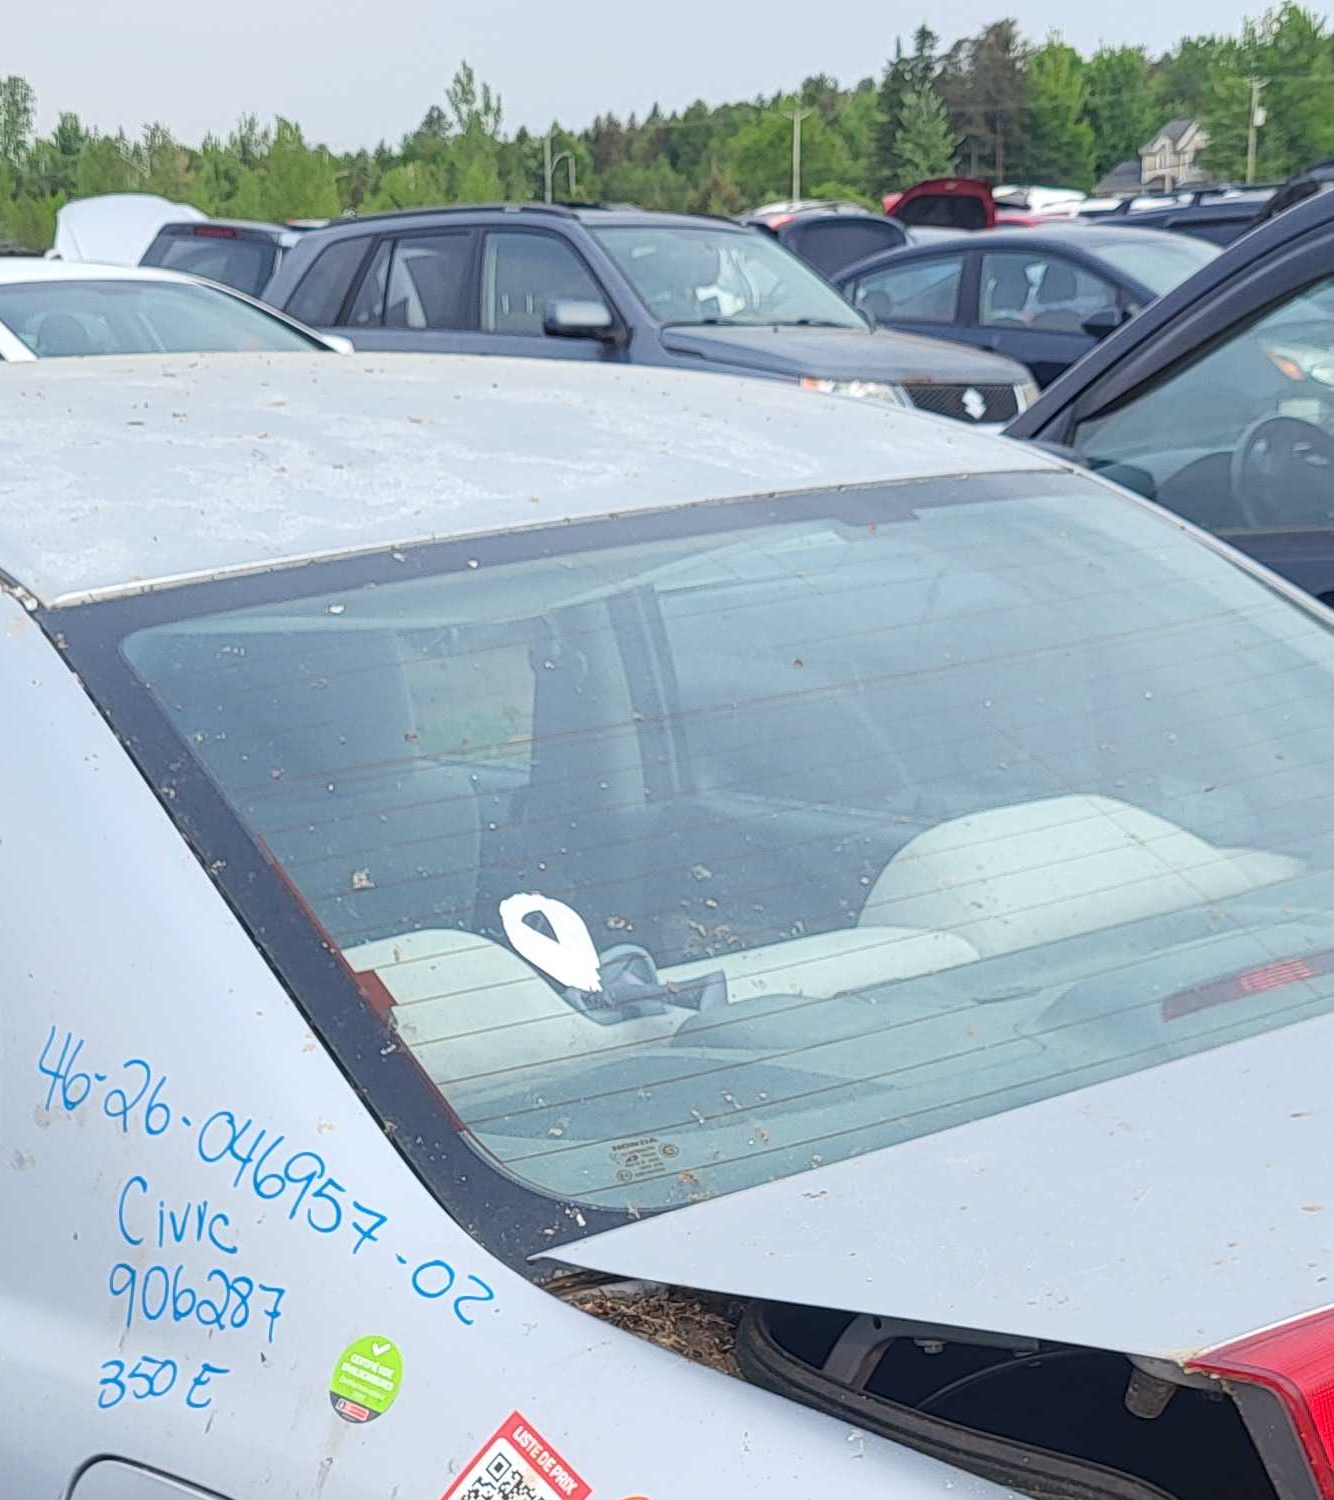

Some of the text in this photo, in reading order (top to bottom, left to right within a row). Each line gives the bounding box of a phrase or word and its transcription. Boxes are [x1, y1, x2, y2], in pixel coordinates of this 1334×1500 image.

[38, 1025, 495, 1325] 46-26-046957-02
[118, 1175, 238, 1254] Civic
[109, 1262, 286, 1343] 906287
[512, 1425, 578, 1496] LISTE DE PRIX
